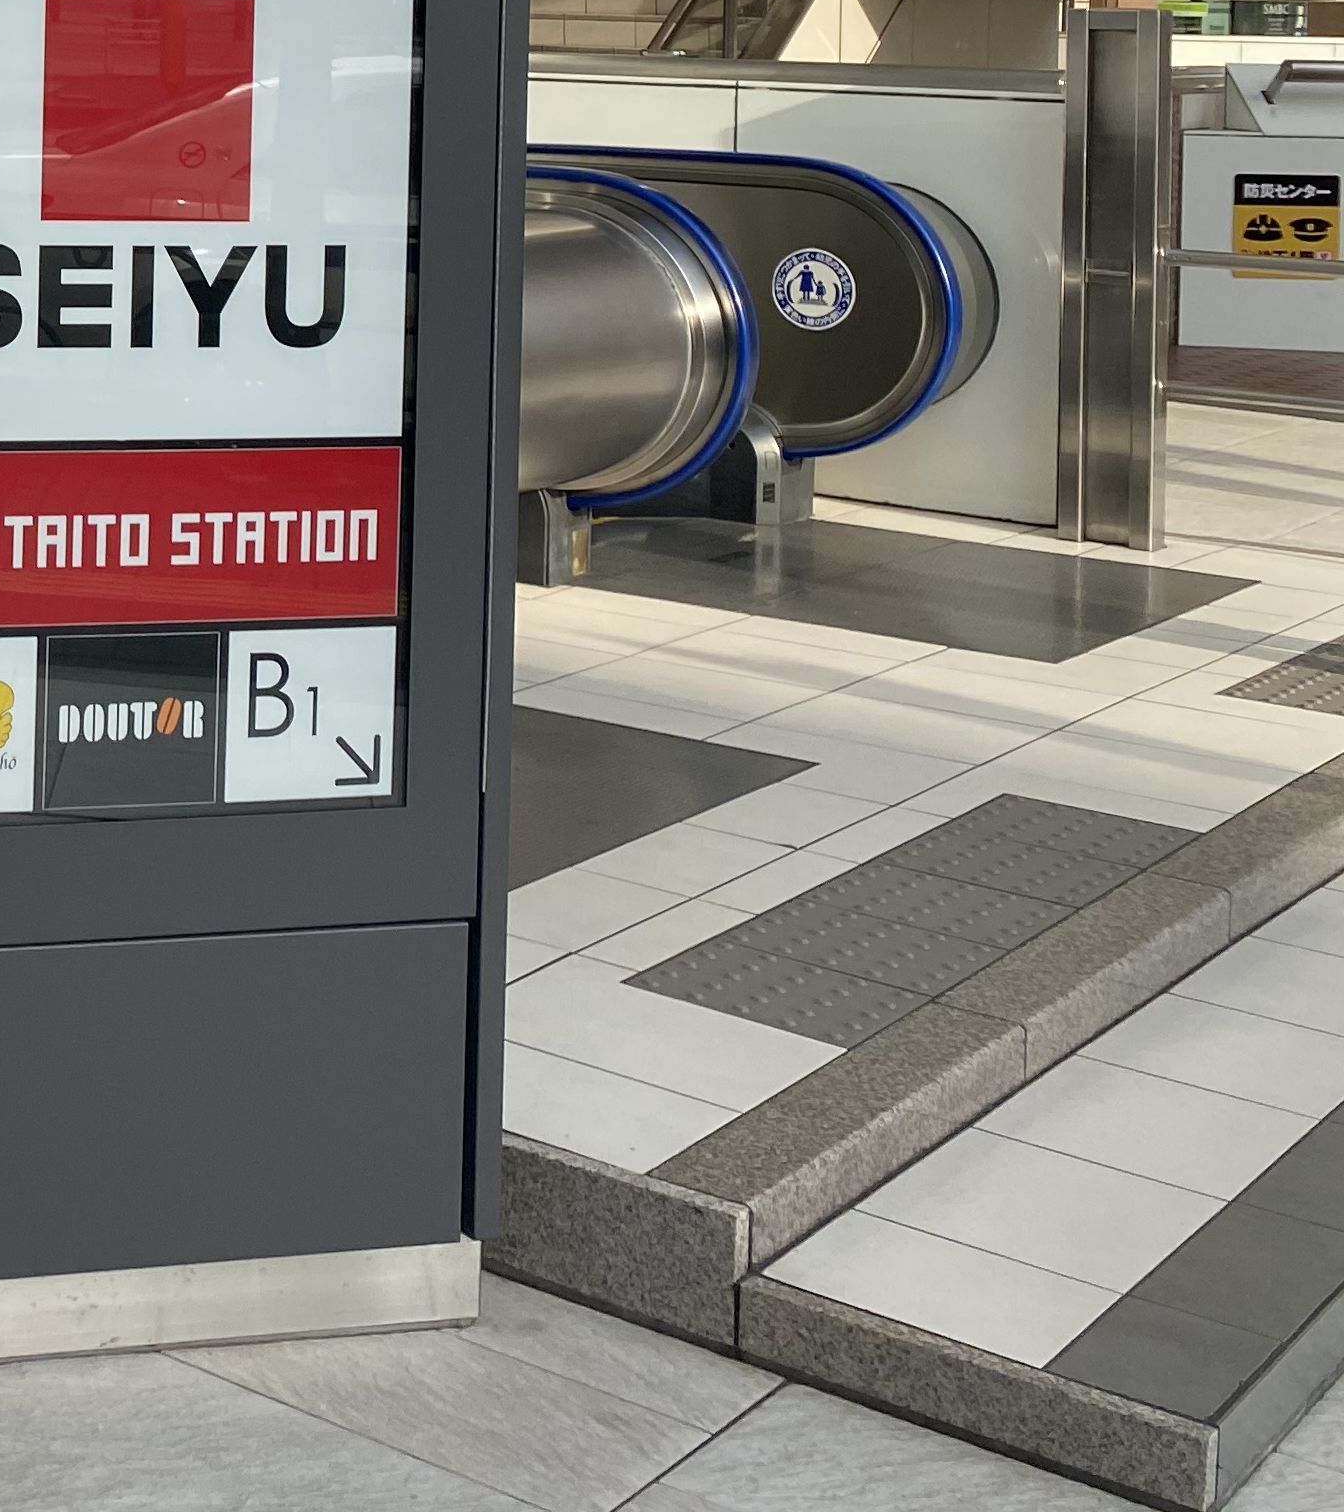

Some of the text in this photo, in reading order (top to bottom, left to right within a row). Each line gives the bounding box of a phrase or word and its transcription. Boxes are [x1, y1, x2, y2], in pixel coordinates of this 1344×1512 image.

[1243, 182, 1332, 199] 防災センター
[4, 509, 378, 569] TAITO STATION
[58, 696, 205, 745] DOUTOR
[247, 652, 319, 740] B1
